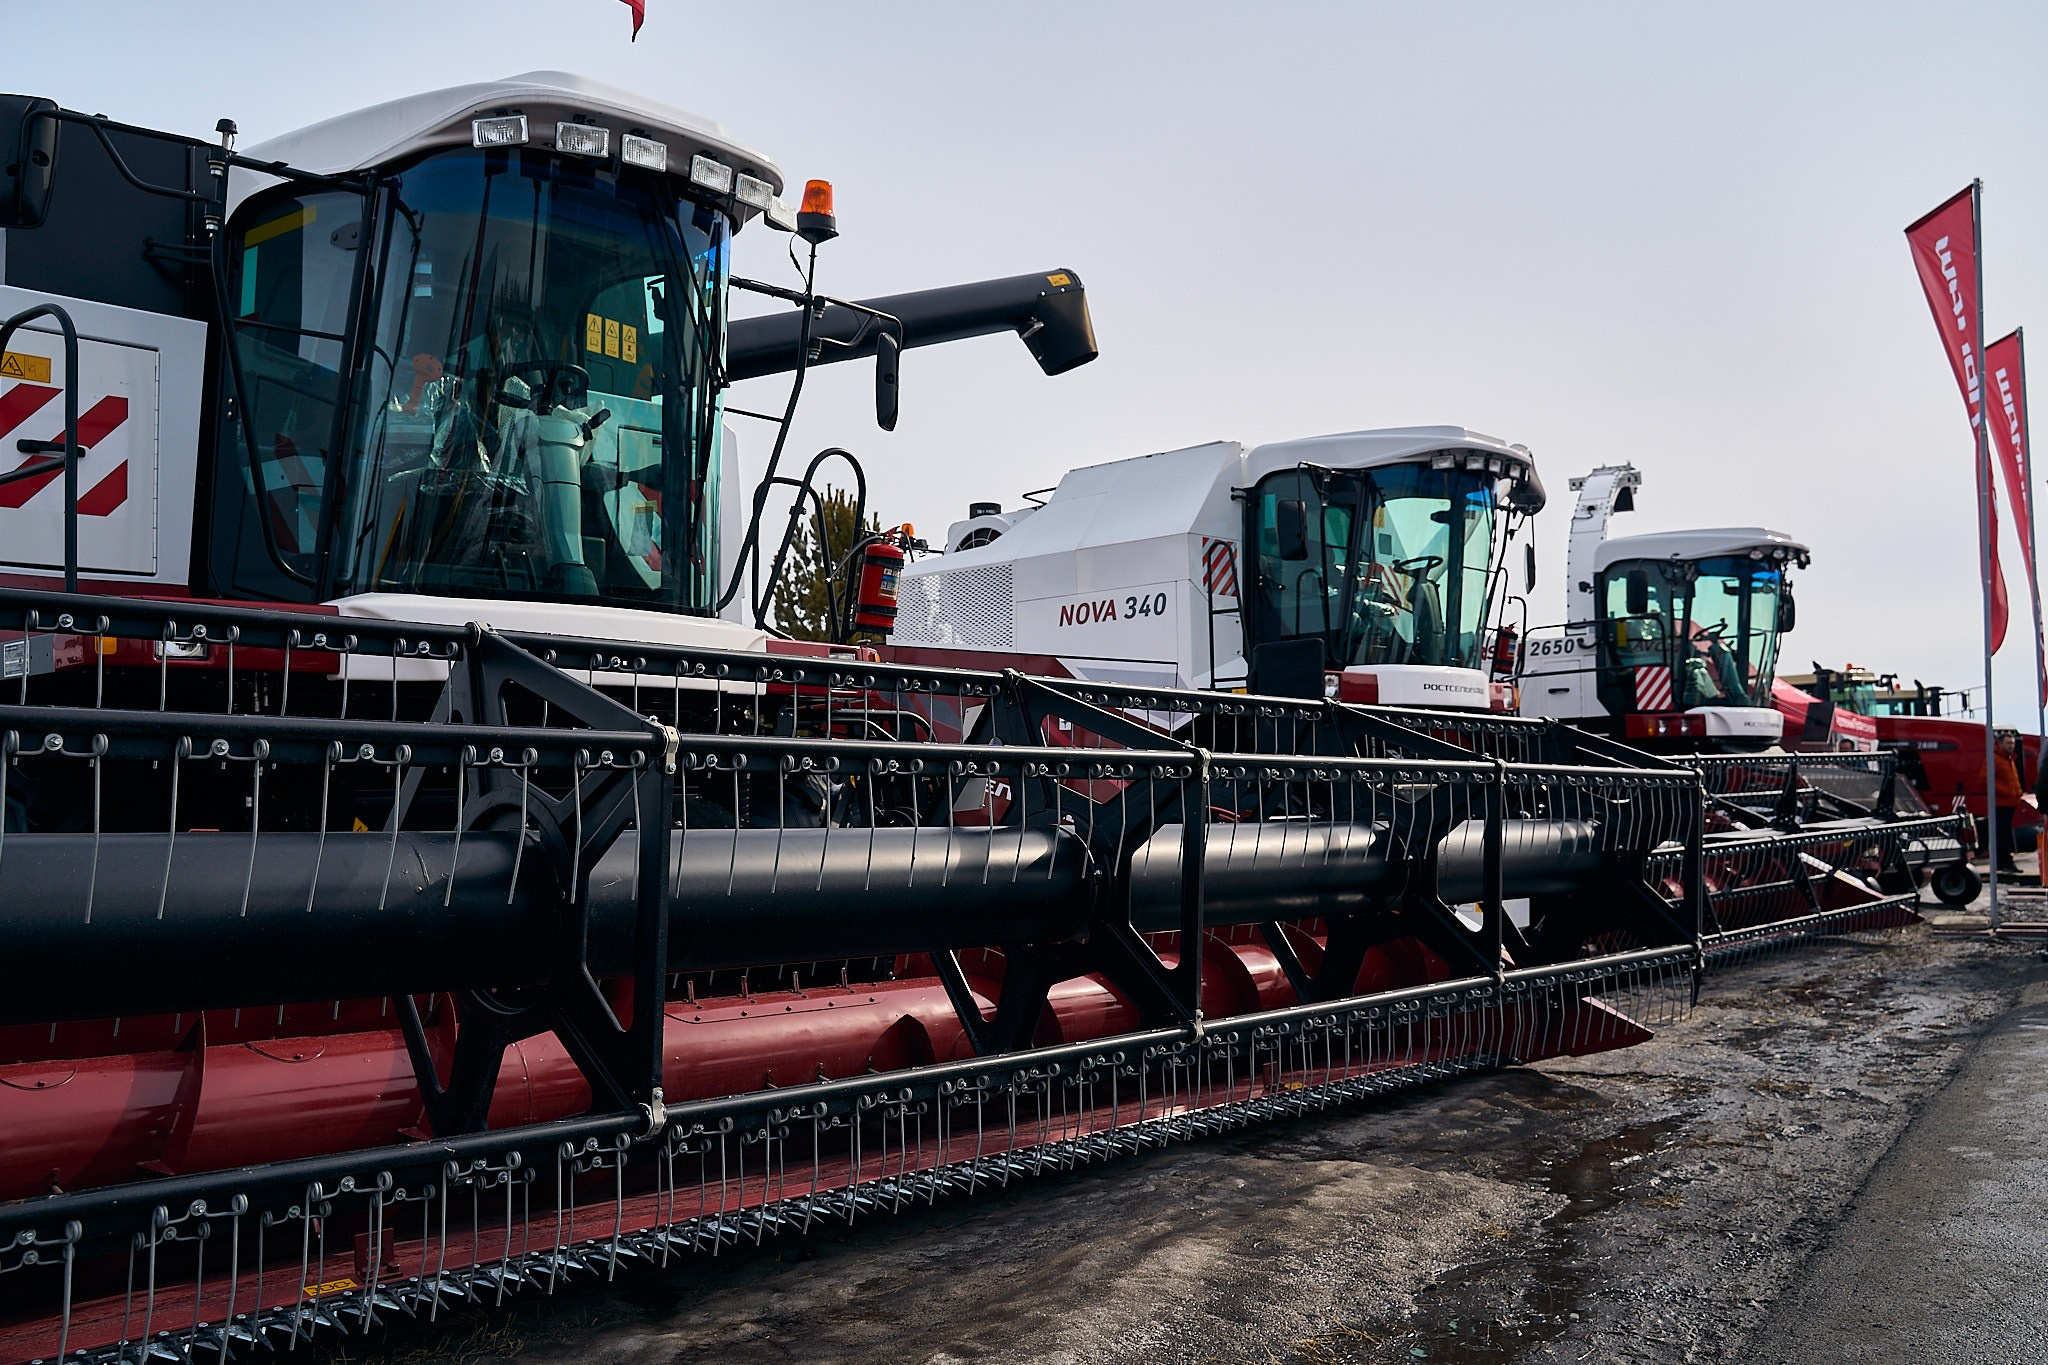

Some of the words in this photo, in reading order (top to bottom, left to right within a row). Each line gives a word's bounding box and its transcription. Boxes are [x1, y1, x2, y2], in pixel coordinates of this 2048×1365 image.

[1059, 599, 1117, 627] NOVA
[1124, 592, 1167, 619] 340
[1530, 639, 1575, 656] 2650
